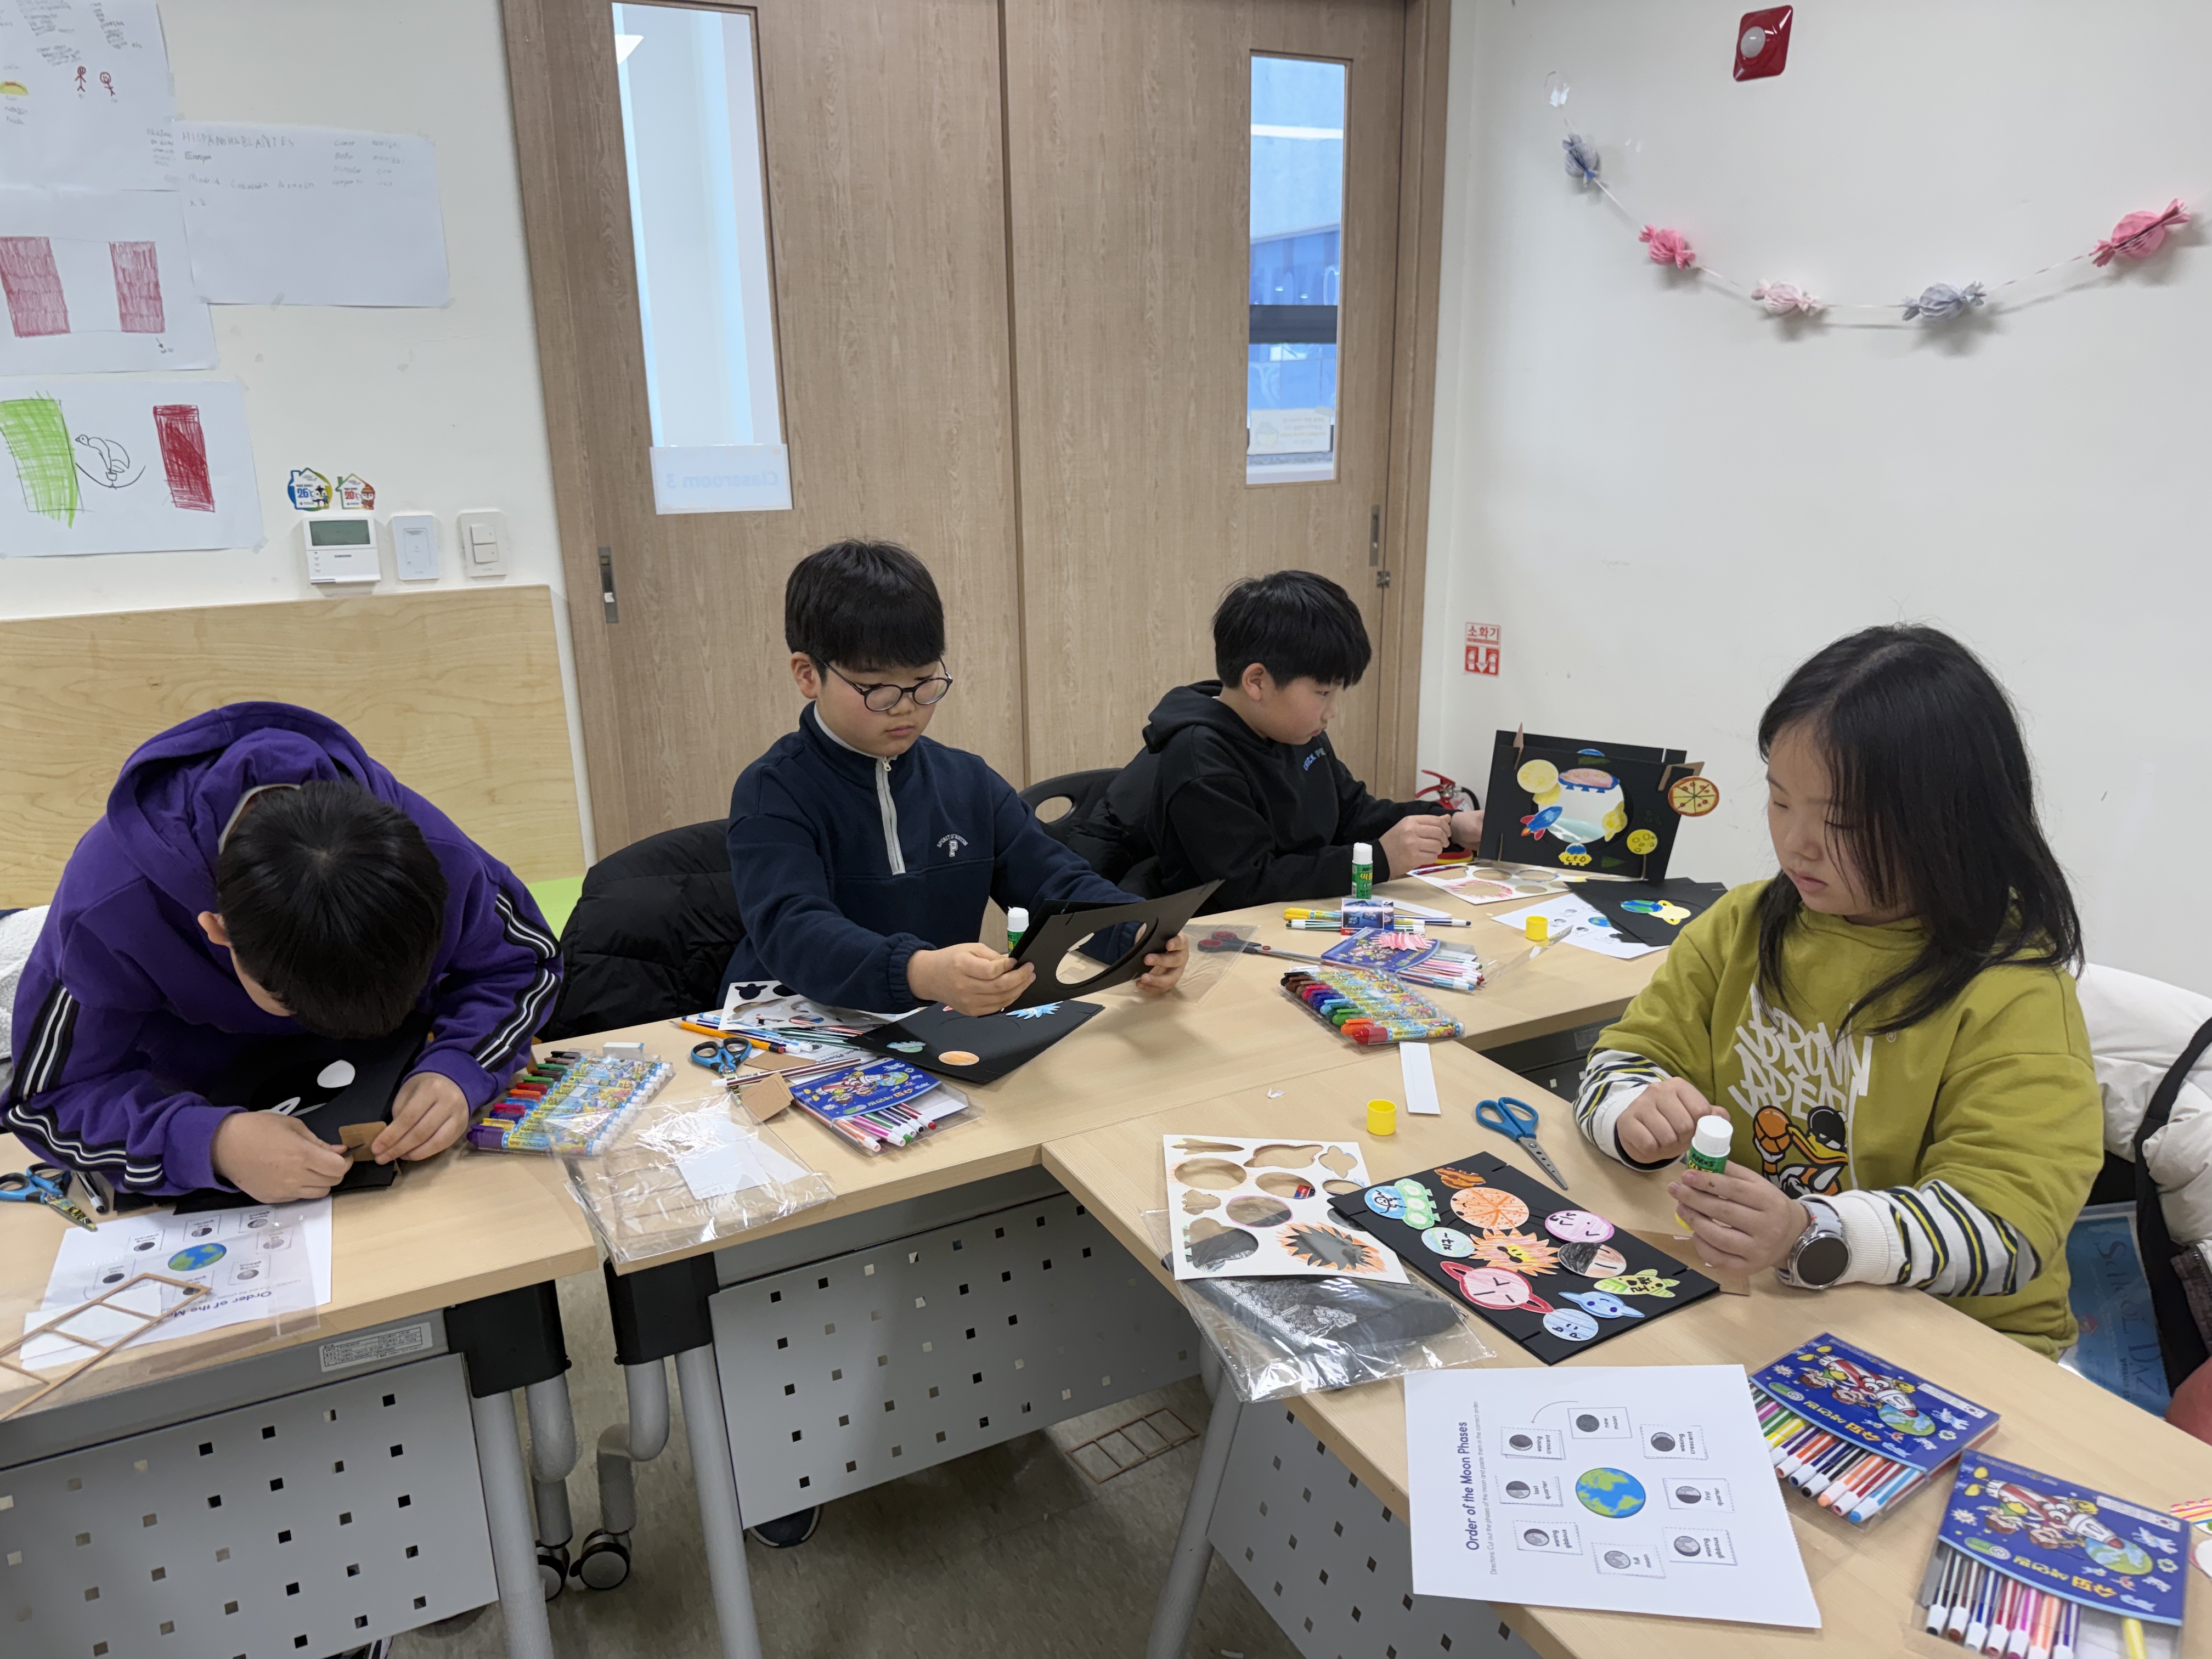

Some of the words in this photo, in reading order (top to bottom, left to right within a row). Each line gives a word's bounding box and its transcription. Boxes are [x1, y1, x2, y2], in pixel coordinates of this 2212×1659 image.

[1467, 625, 1499, 641] 소화기
[936, 834, 950, 848] SPIRIT
[949, 839, 958, 857] P
[213, 1300, 228, 1310] of
[235, 1291, 272, 1304] Order
[190, 1302, 212, 1313] the
[1457, 1421, 1470, 1454] Phases
[1687, 1431, 1695, 1454] crescent
[1459, 1457, 1473, 1484] Moon
[1462, 1487, 1475, 1502] the
[1542, 1481, 1552, 1500] quarter
[1714, 1487, 1724, 1506] quarter
[1462, 1503, 1476, 1515] of
[1484, 1508, 1492, 1523] phases
[1465, 1517, 1480, 1550] Order
[1562, 1529, 1572, 1548] gibbous
[1714, 1537, 1725, 1559] gibbous
[1644, 1554, 1652, 1568] moon
